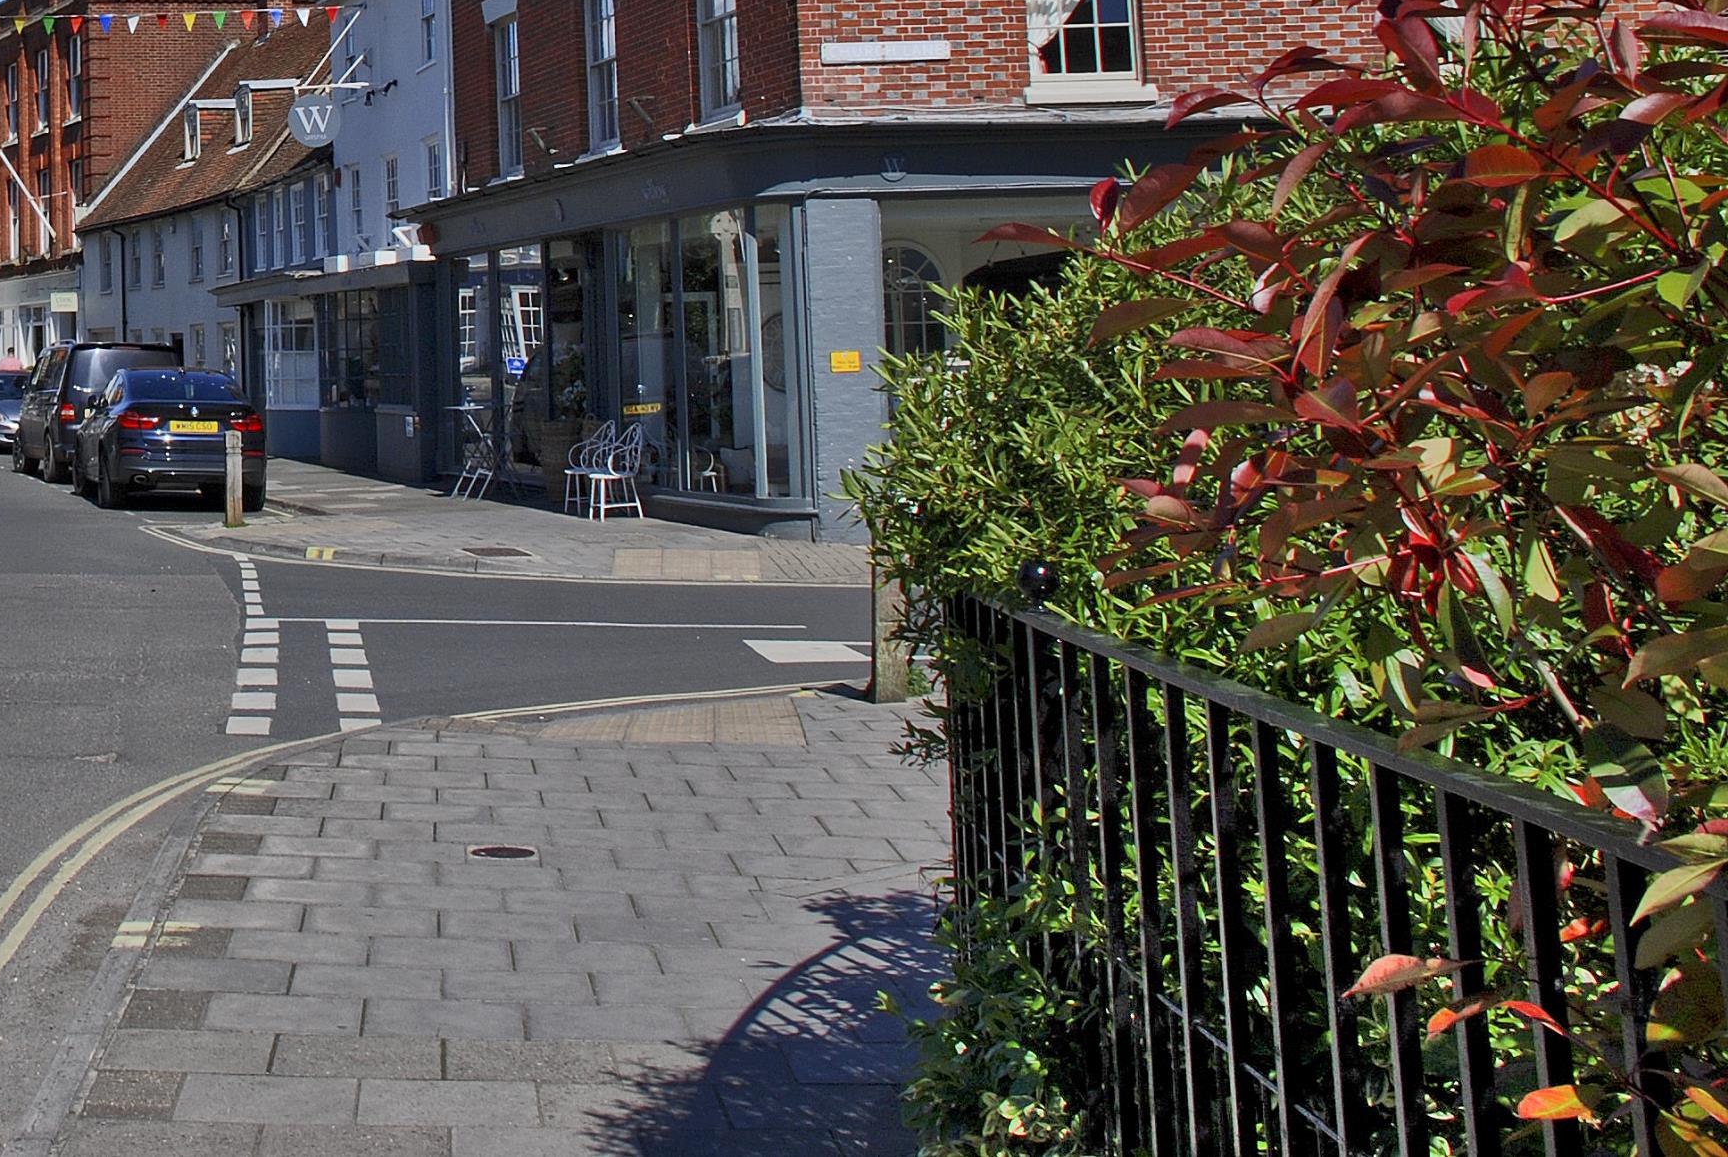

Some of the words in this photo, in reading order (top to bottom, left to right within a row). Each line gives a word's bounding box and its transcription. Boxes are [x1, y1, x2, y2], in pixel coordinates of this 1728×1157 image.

[829, 45, 895, 59] CHURCH
[903, 44, 945, 57] LANE
[294, 105, 333, 134] W
